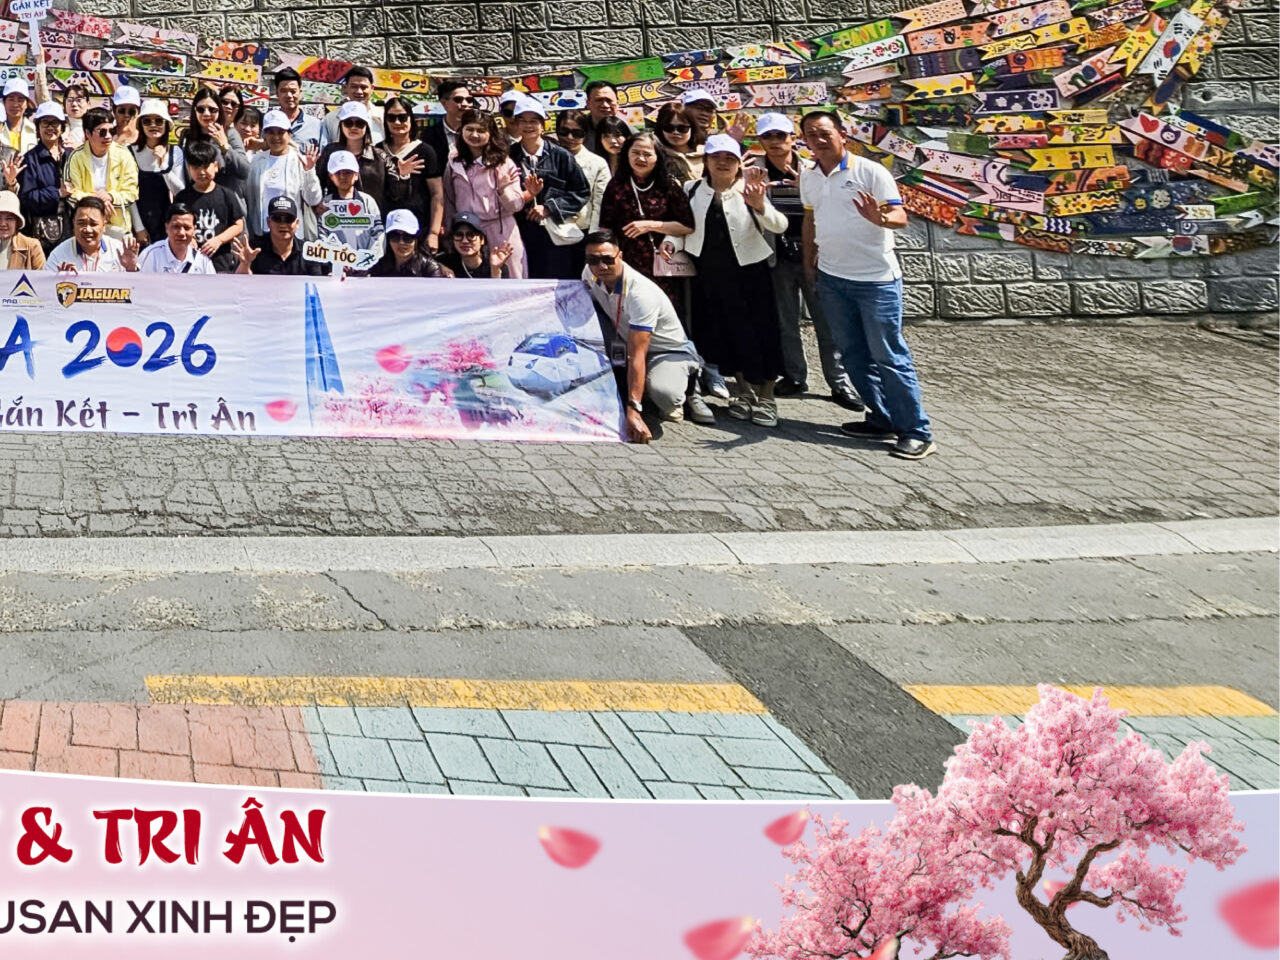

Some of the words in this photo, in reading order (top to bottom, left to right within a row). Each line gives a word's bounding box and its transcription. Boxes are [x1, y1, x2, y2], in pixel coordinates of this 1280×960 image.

[76, 288, 131, 300] JAGUAR
[61, 315, 217, 378] 2026
[55, 397, 112, 429] Kết
[210, 396, 257, 431] Ân
